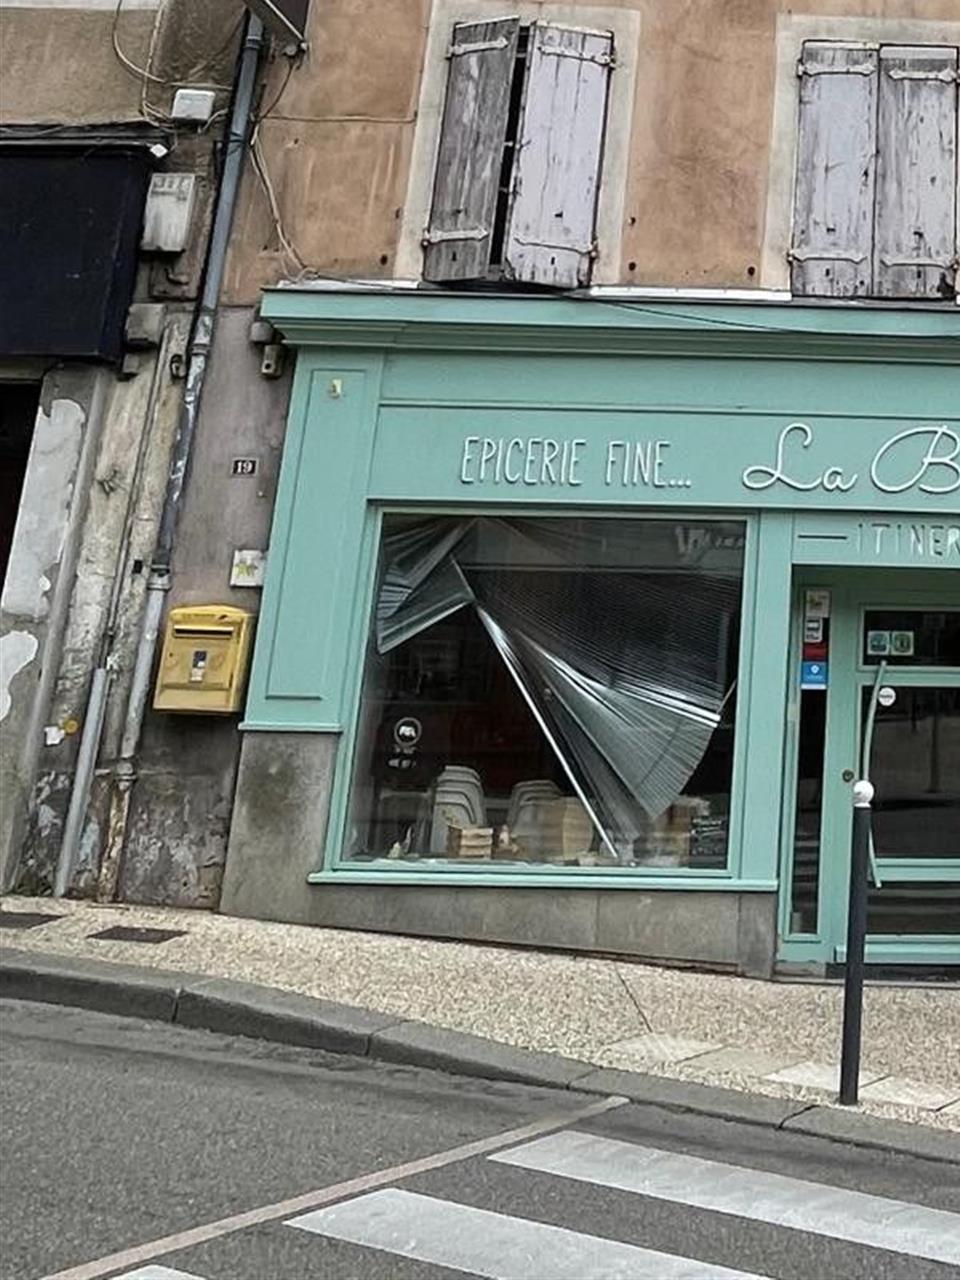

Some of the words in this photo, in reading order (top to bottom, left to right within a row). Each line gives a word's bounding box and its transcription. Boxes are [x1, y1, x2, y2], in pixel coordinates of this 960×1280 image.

[237, 460, 253, 474] 19
[460, 436, 587, 487] EPICERIE
[605, 440, 692, 489] FINE...
[742, 422, 858, 491] La
